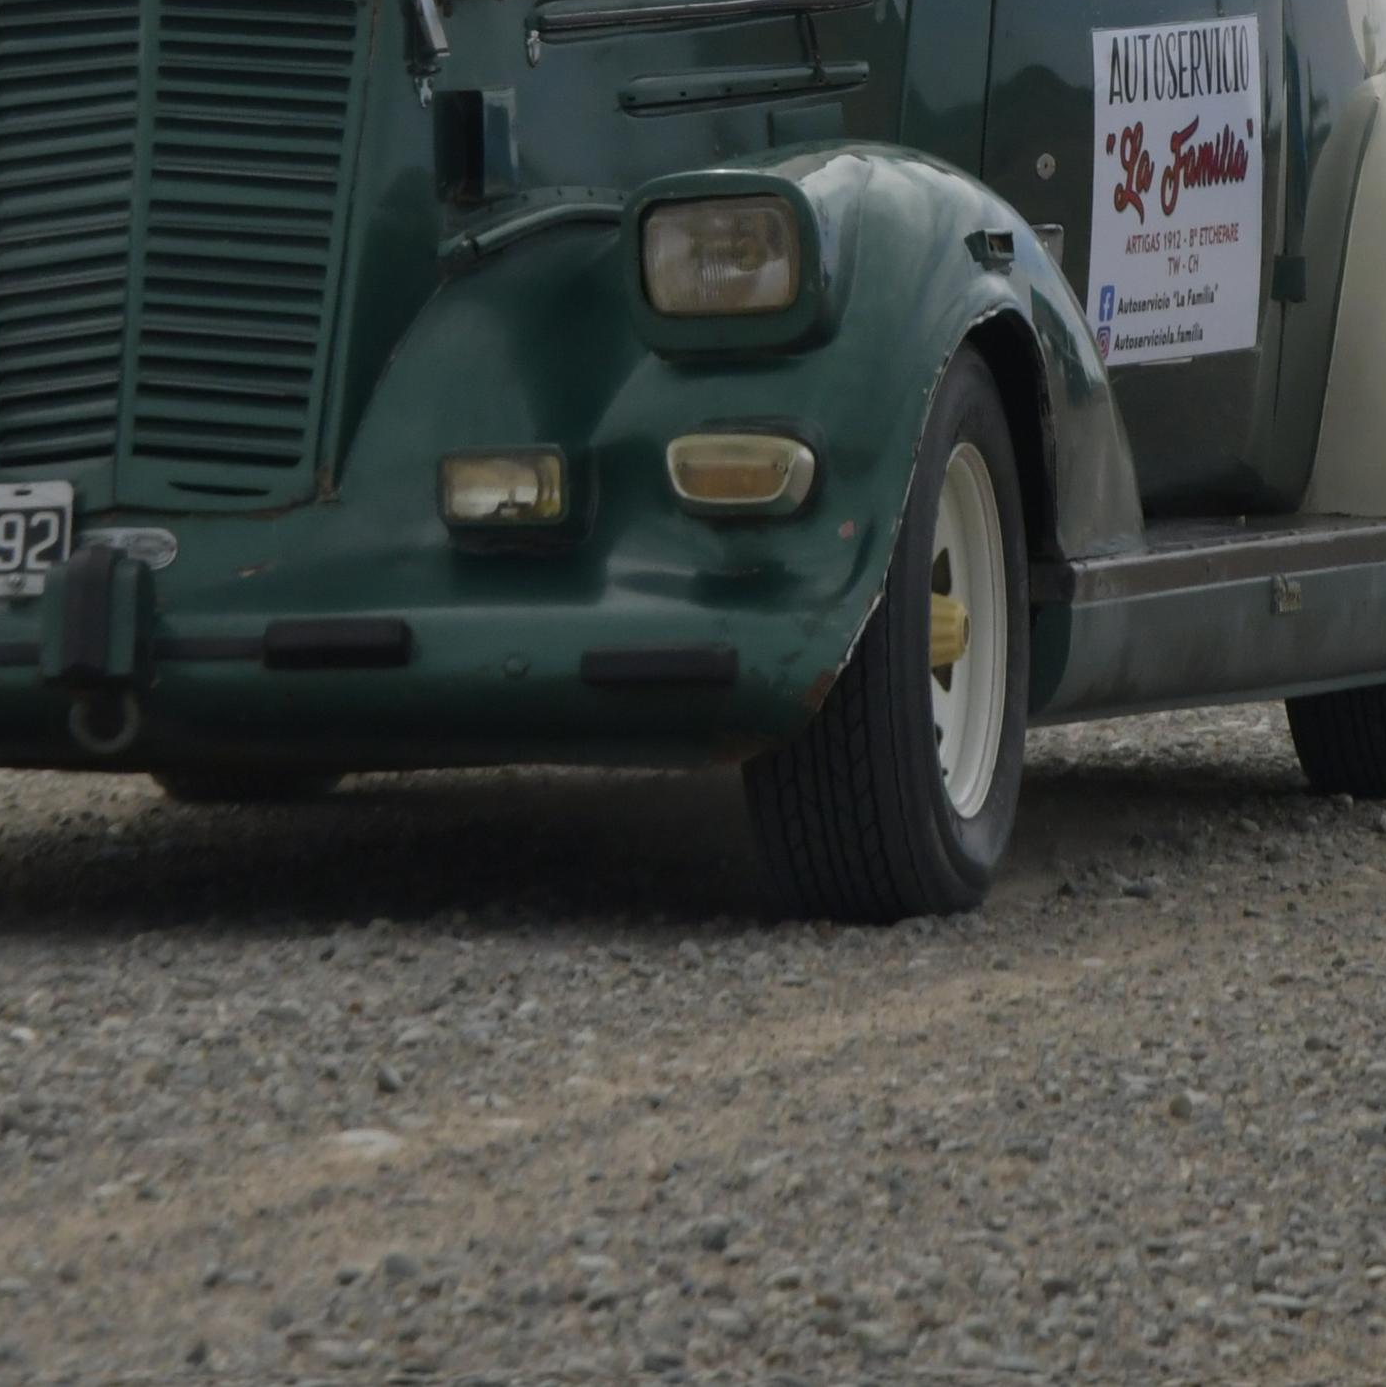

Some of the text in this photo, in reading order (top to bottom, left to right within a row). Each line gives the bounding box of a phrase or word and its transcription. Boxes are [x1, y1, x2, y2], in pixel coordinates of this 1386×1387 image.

[1109, 25, 1249, 105] AUTOSERVICIO
[1125, 233, 1160, 255] ARTIGAS
[1164, 230, 1182, 251] 1912
[1199, 222, 1240, 246] ETCHEPARE
[1168, 257, 1181, 276] TW
[1188, 254, 1199, 273] CH
[1117, 293, 1170, 315] Autoservicio
